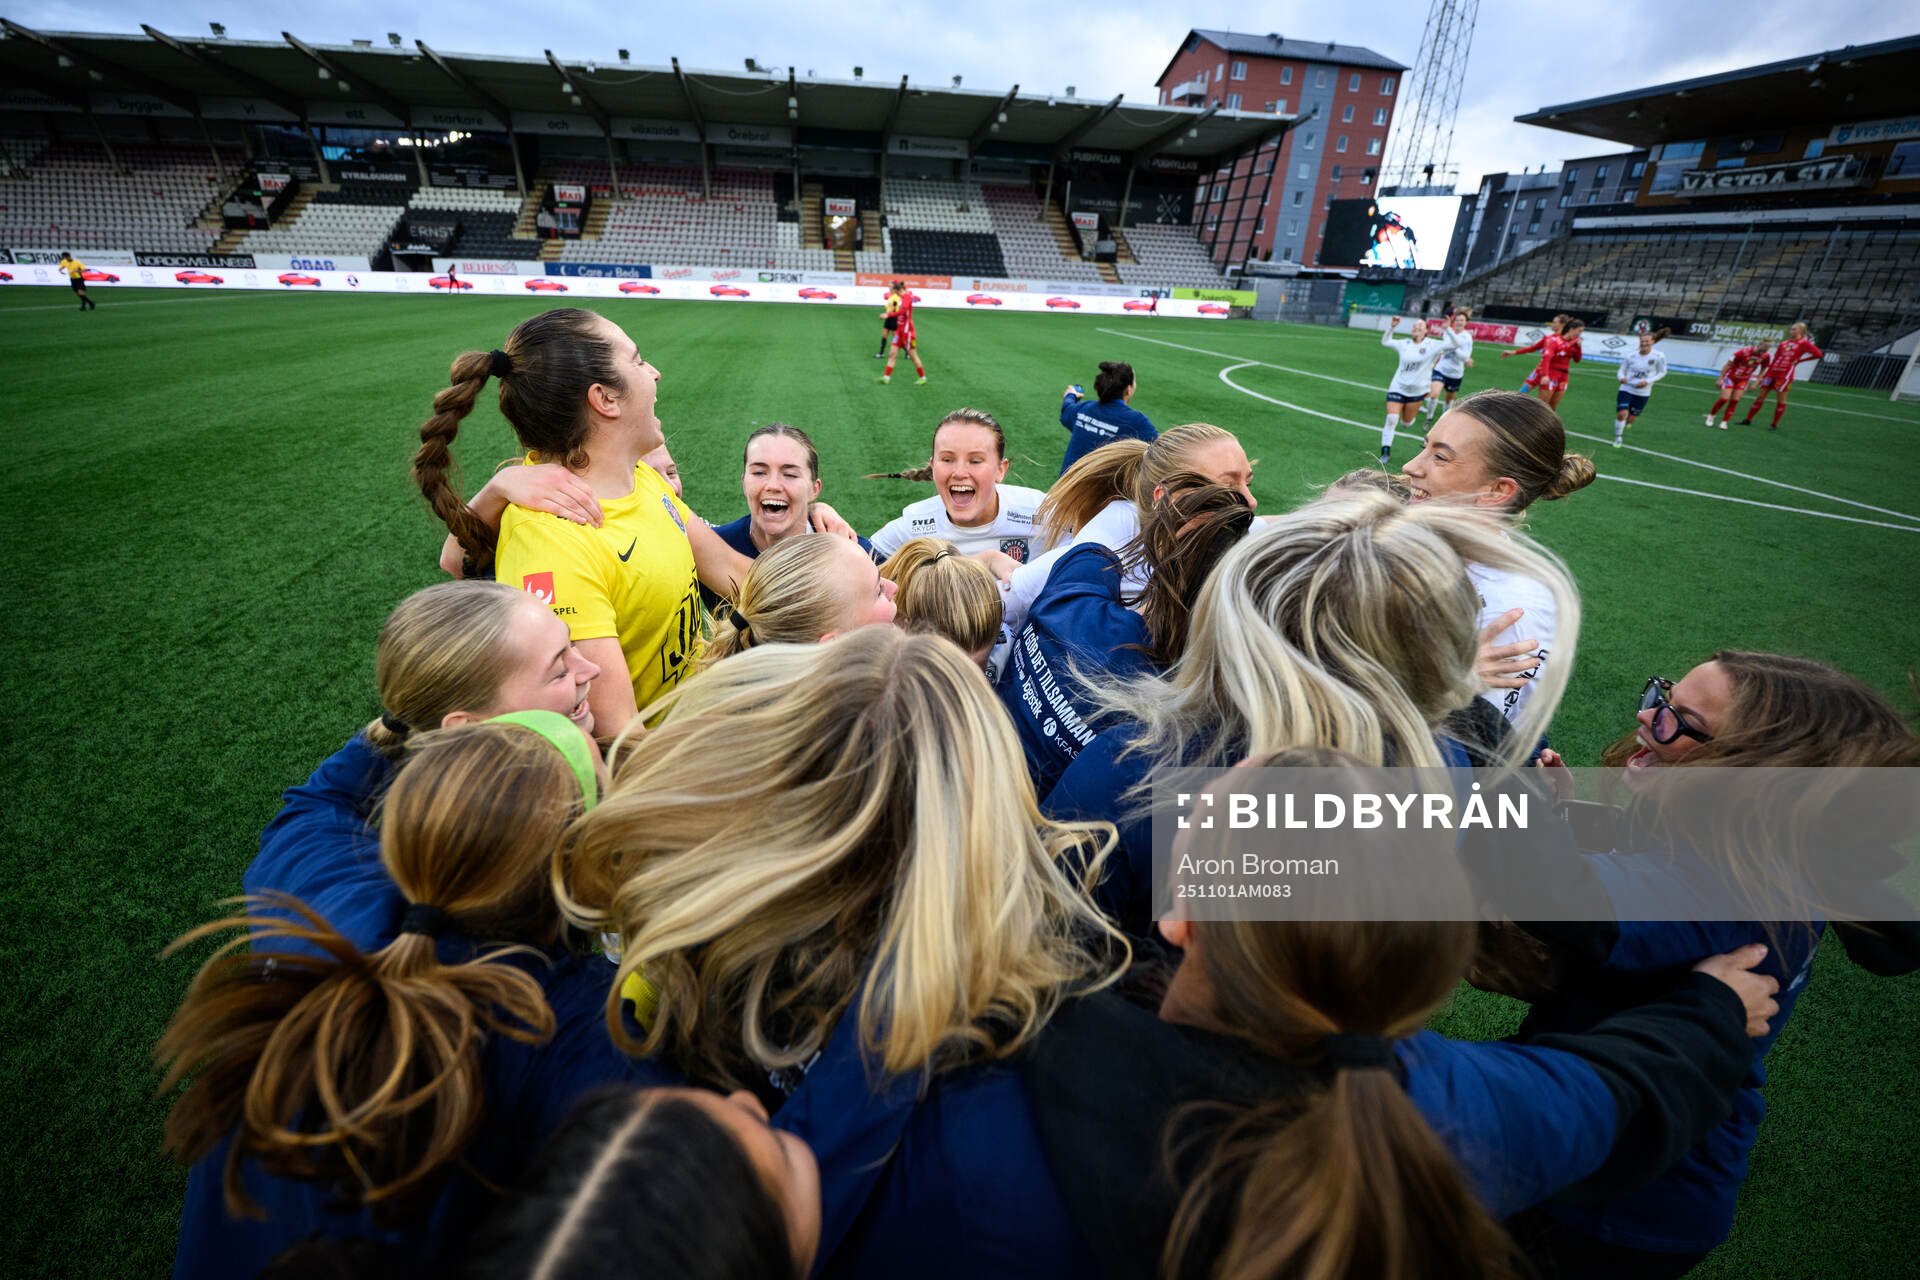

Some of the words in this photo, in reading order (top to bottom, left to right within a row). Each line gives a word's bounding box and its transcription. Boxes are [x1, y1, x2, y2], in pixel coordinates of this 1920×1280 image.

[547, 119, 569, 130] och
[409, 225, 455, 238] ERNST
[578, 266, 602, 277] Care
[616, 266, 640, 279] Beds
[774, 273, 805, 283] FRONT
[912, 518, 936, 526] SVEA
[553, 606, 578, 616] SPEL
[1025, 632, 1039, 656] GÖR
[1031, 650, 1048, 674] DET
[1022, 677, 1043, 719] logistik
